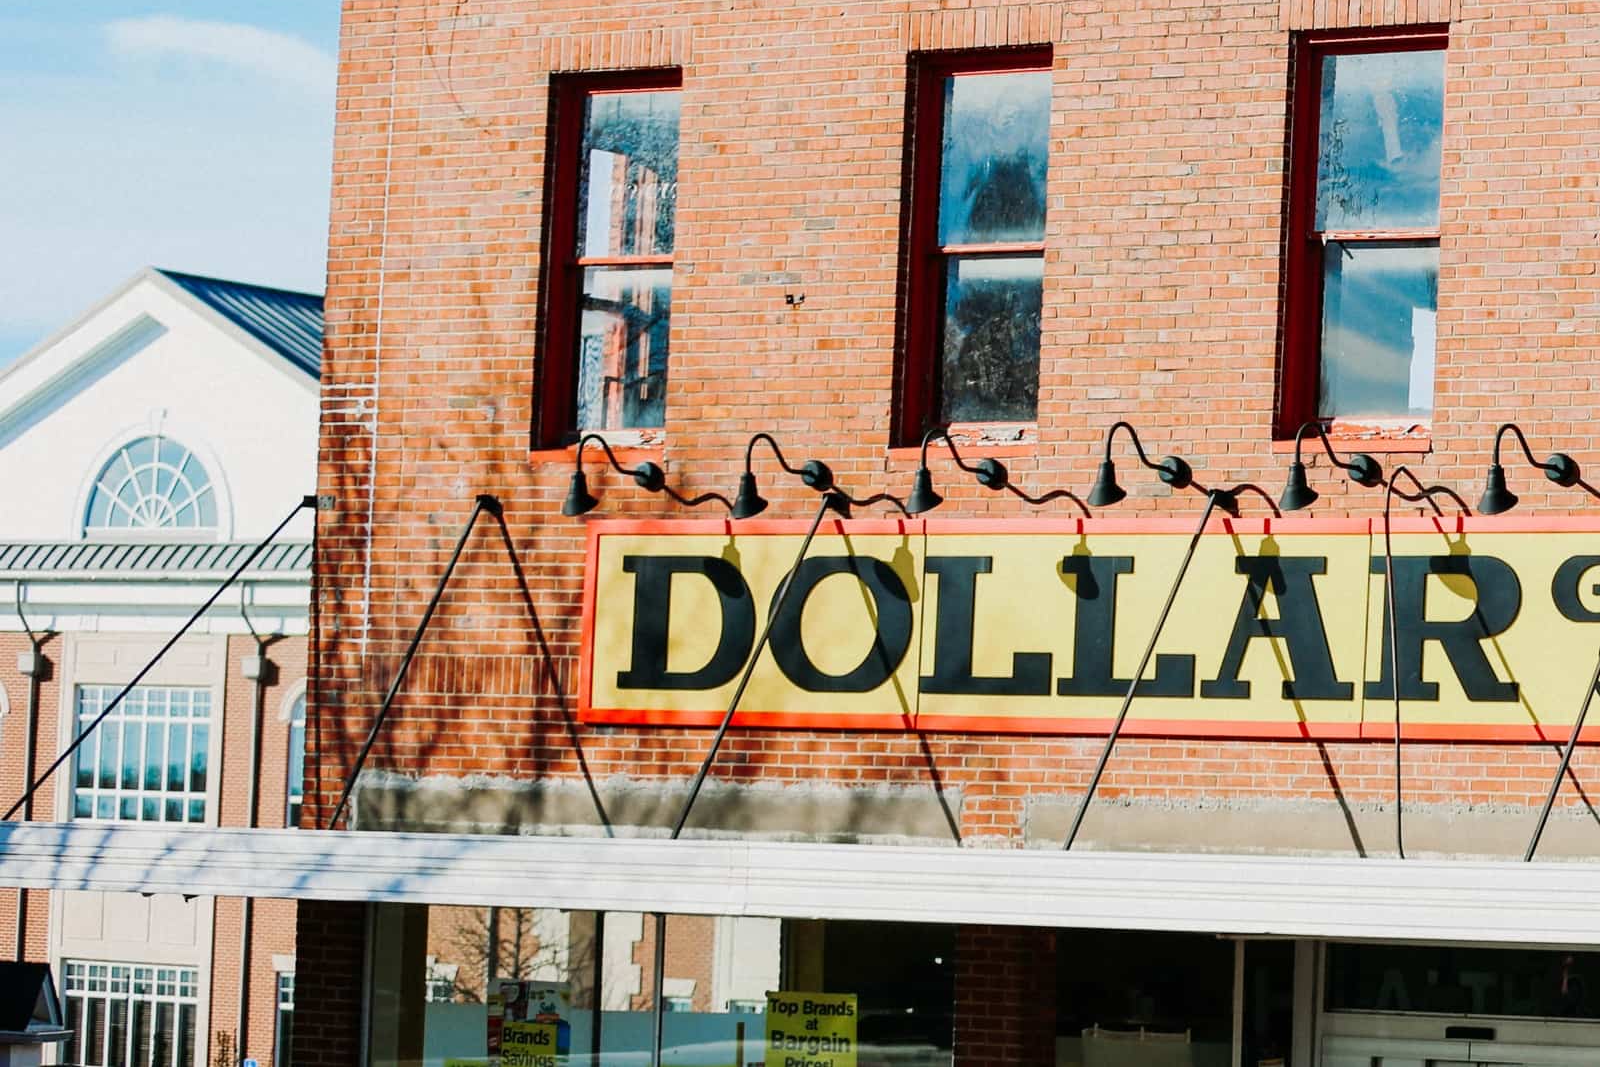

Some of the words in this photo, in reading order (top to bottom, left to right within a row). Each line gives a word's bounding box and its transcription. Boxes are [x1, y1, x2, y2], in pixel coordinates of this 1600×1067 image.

[617, 555, 1522, 702] DOLLAR
[769, 998, 799, 1016] Top
[803, 1000, 854, 1016] Brands
[805, 1018, 818, 1031] at
[503, 1027, 550, 1046] Brands
[771, 1030, 850, 1055] Bargain
